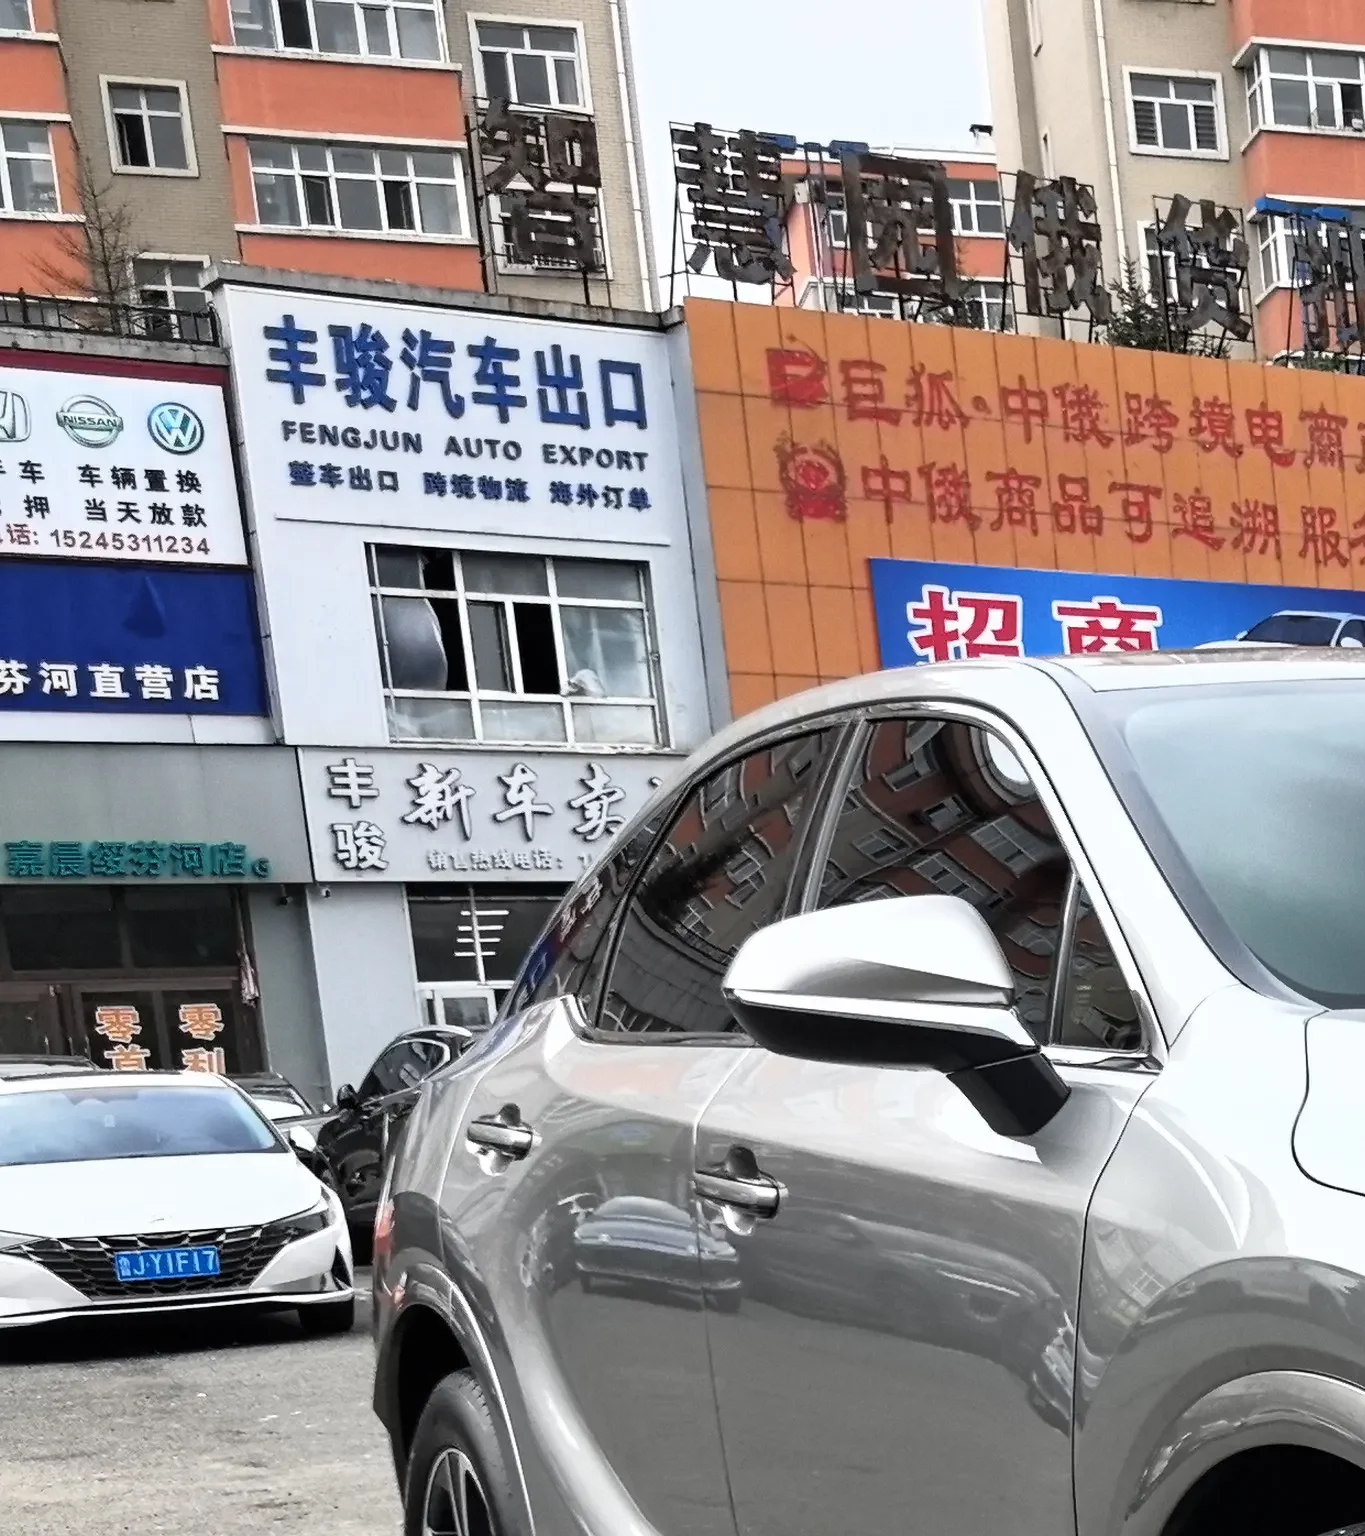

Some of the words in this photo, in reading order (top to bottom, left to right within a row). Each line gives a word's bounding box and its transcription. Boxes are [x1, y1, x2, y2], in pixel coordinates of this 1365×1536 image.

[263, 315, 649, 430] 丰骏汽车出口
[63, 414, 118, 428] NISSAN
[282, 420, 422, 454] FENGJUN
[444, 435, 523, 462] AUTO
[541, 443, 649, 472] EXPORT
[77, 464, 202, 493] 车辆置换
[288, 460, 400, 492] 整车出口
[423, 471, 531, 503] 跨境物流
[549, 480, 652, 511] 海外订单
[85, 497, 207, 528] 当天放款
[50, 528, 211, 555] 15245311234
[907, 584, 1163, 662] 招商
[0, 658, 220, 701] 芬河直营店
[326, 757, 390, 871] 丰骏
